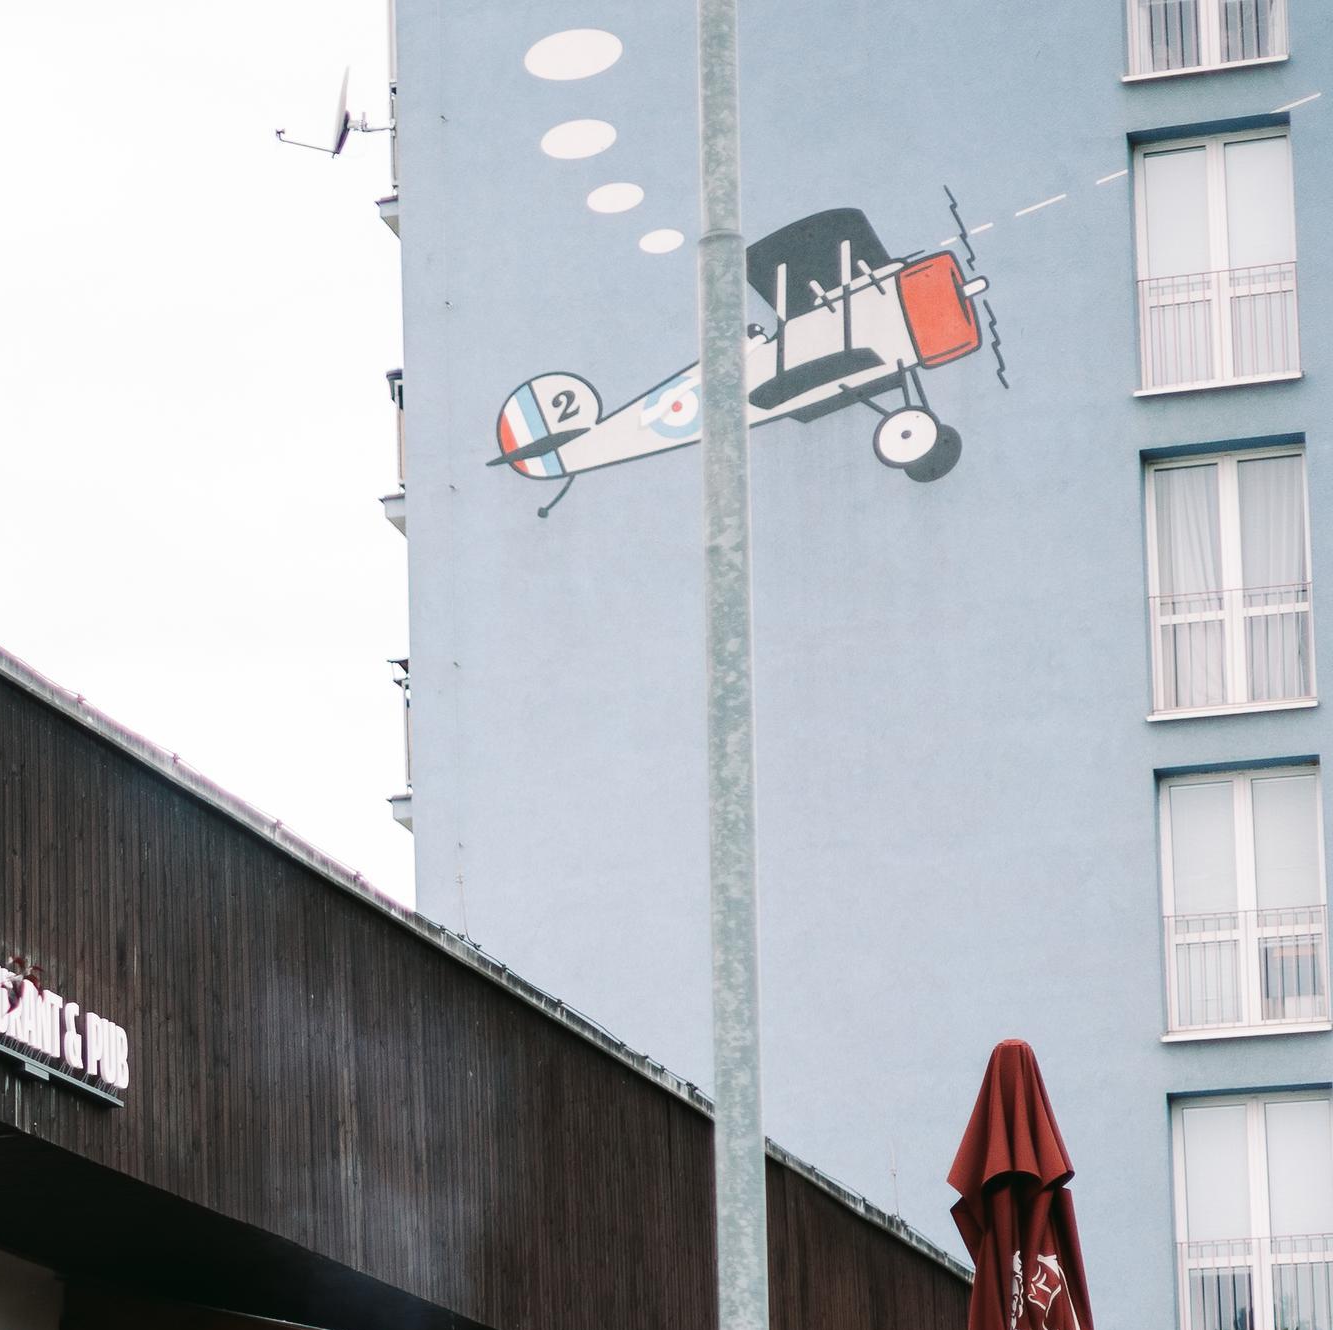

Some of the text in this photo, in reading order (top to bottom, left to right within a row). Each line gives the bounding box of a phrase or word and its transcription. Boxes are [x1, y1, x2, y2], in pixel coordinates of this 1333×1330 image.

[551, 390, 580, 423] 2
[65, 1002, 83, 1069] &
[86, 1012, 129, 1089] PUB
